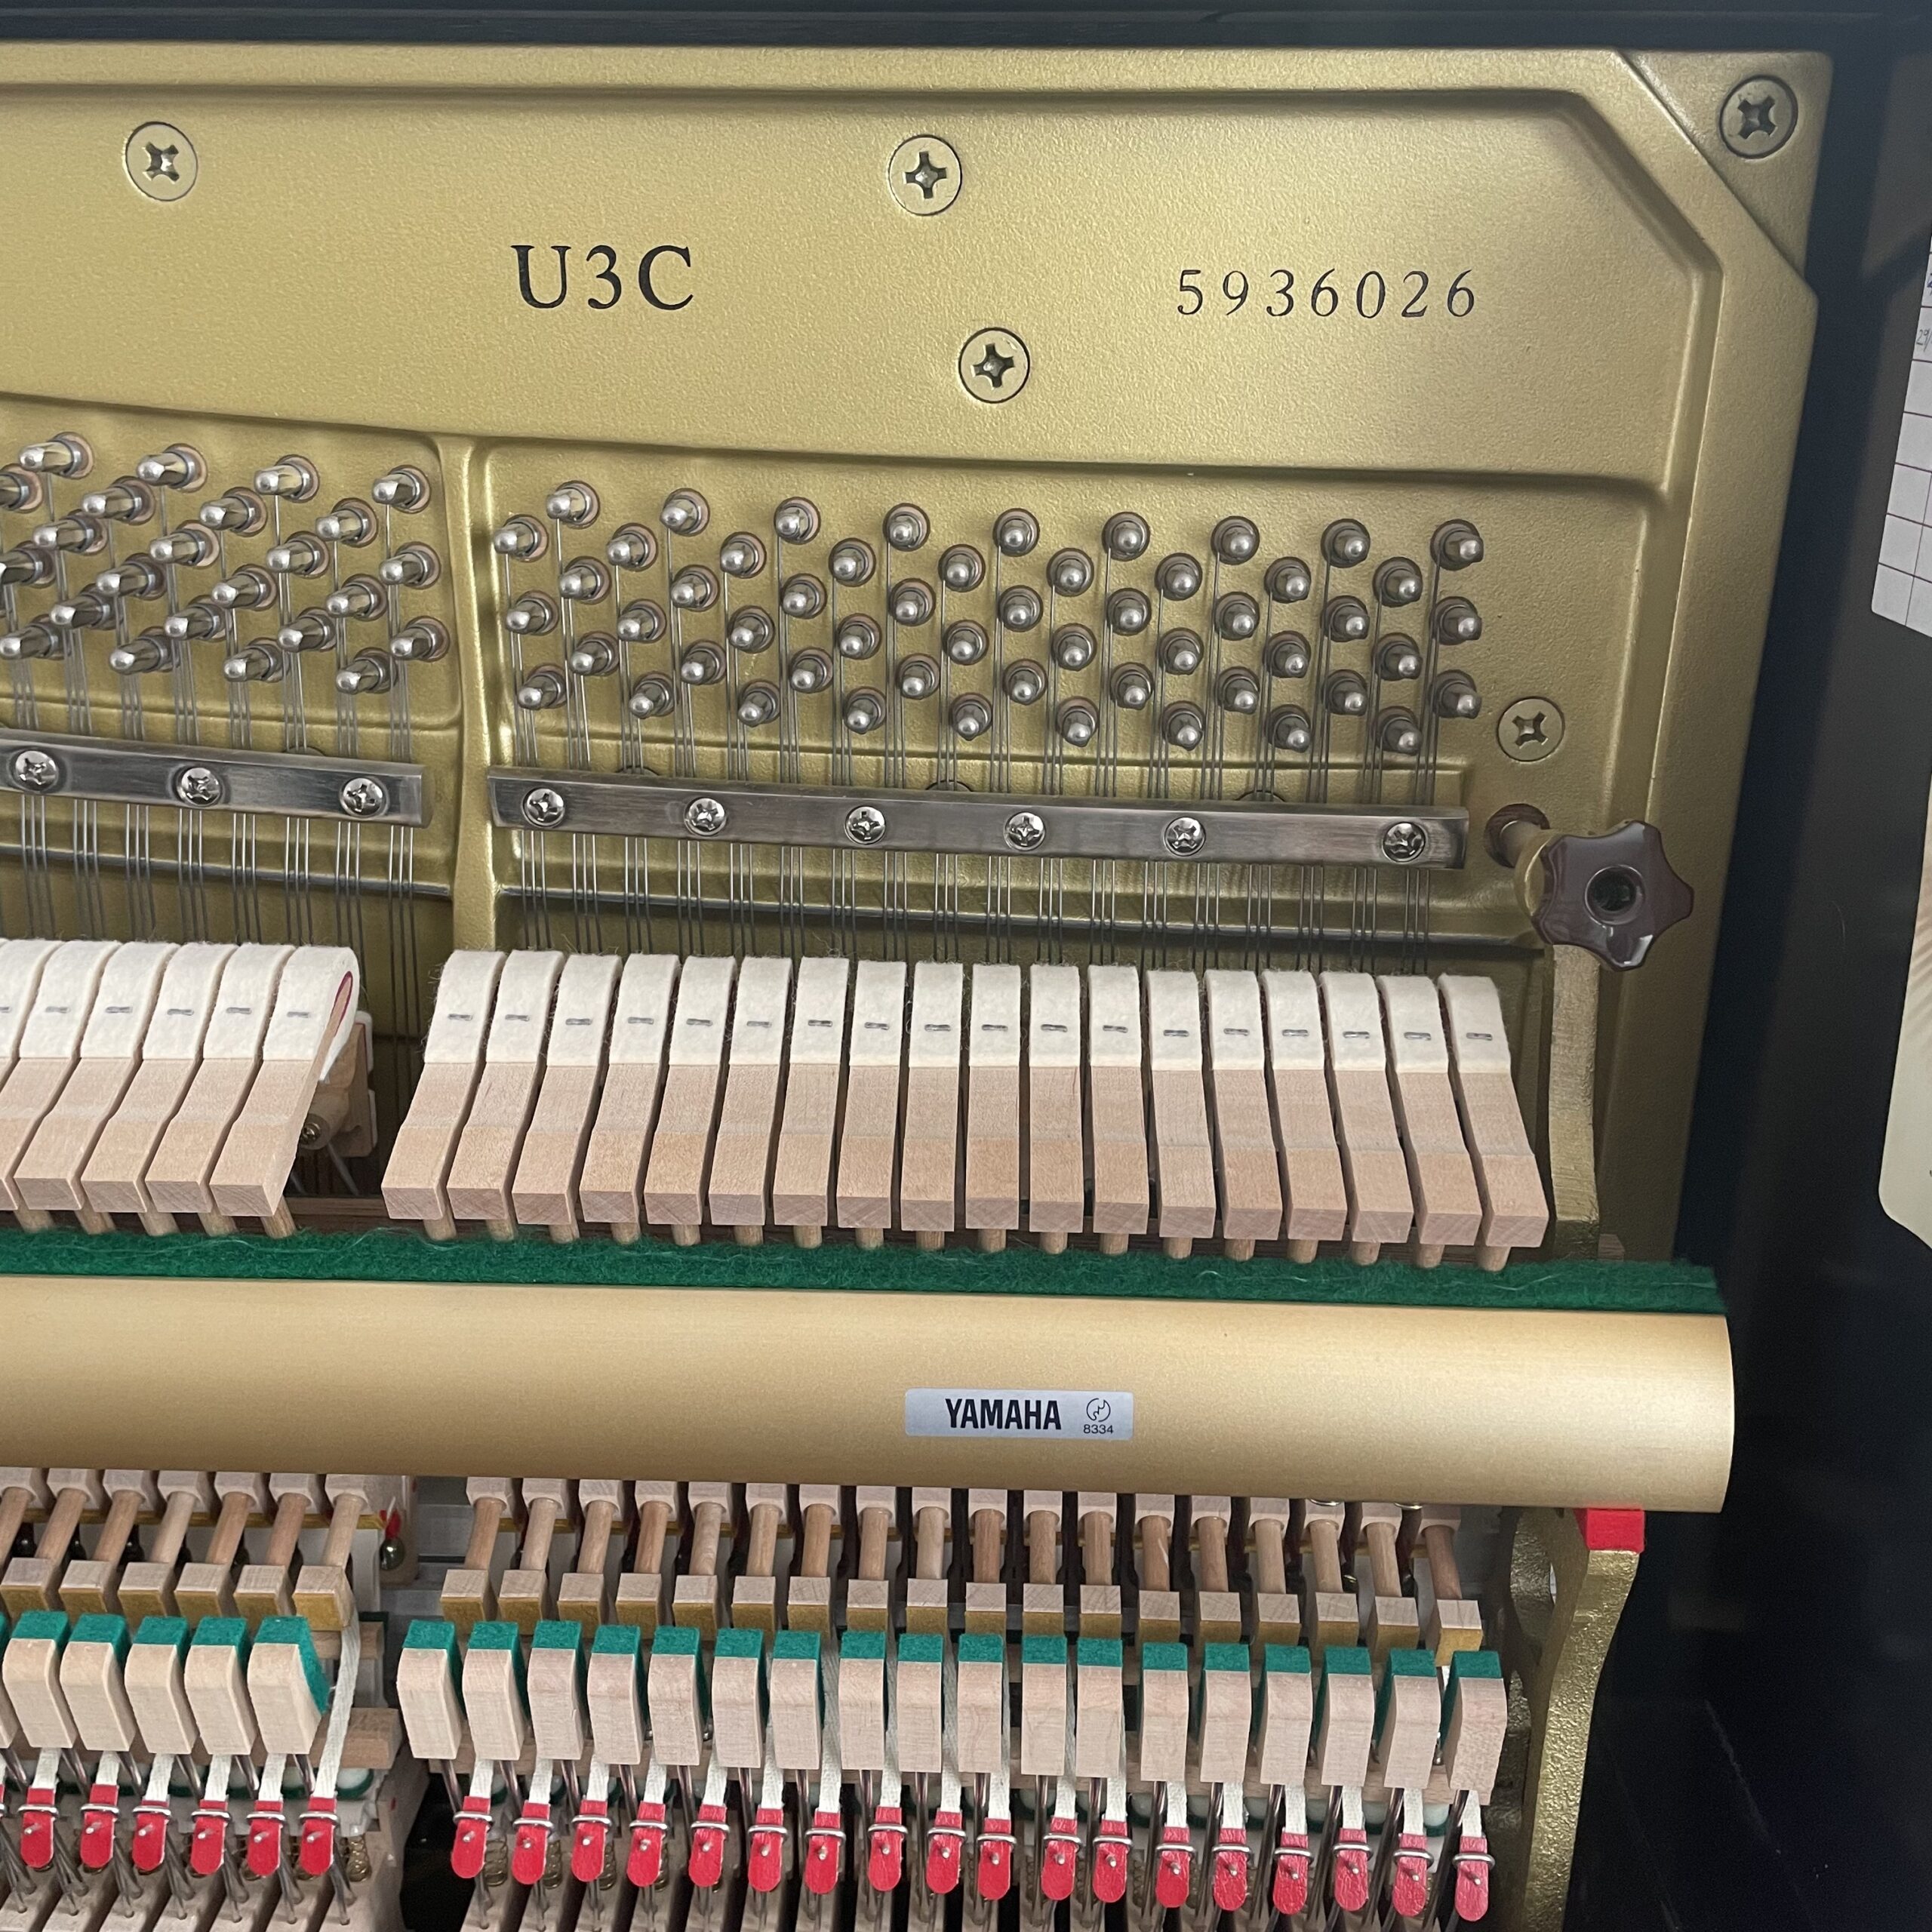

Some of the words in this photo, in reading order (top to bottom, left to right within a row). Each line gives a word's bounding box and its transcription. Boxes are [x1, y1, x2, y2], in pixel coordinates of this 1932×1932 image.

[510, 245, 694, 311] U3C
[1177, 267, 1475, 319] 5936026
[945, 1398, 1062, 1430] YAMAHA
[1083, 1424, 1114, 1435] 8334
